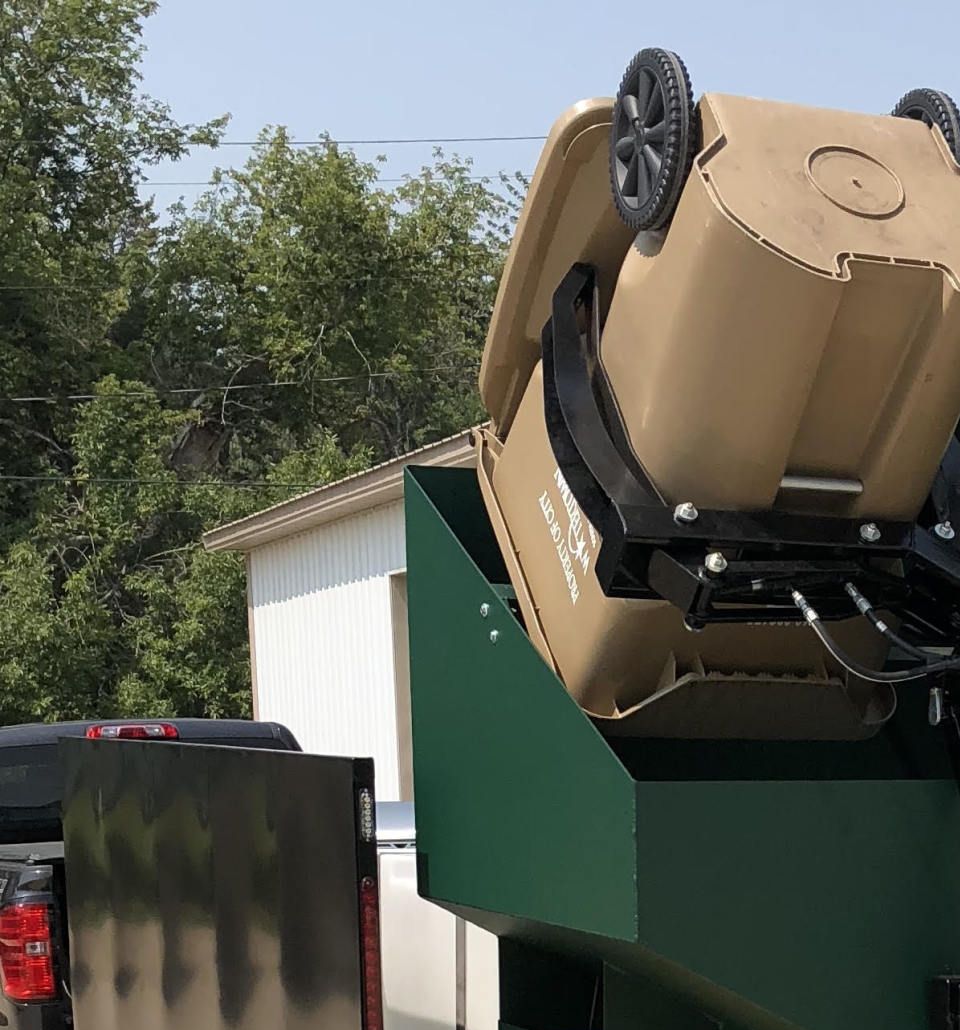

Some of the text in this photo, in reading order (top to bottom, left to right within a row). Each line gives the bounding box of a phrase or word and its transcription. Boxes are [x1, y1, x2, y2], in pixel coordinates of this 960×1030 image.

[538, 490, 580, 605] PROPERTY OF CITY
